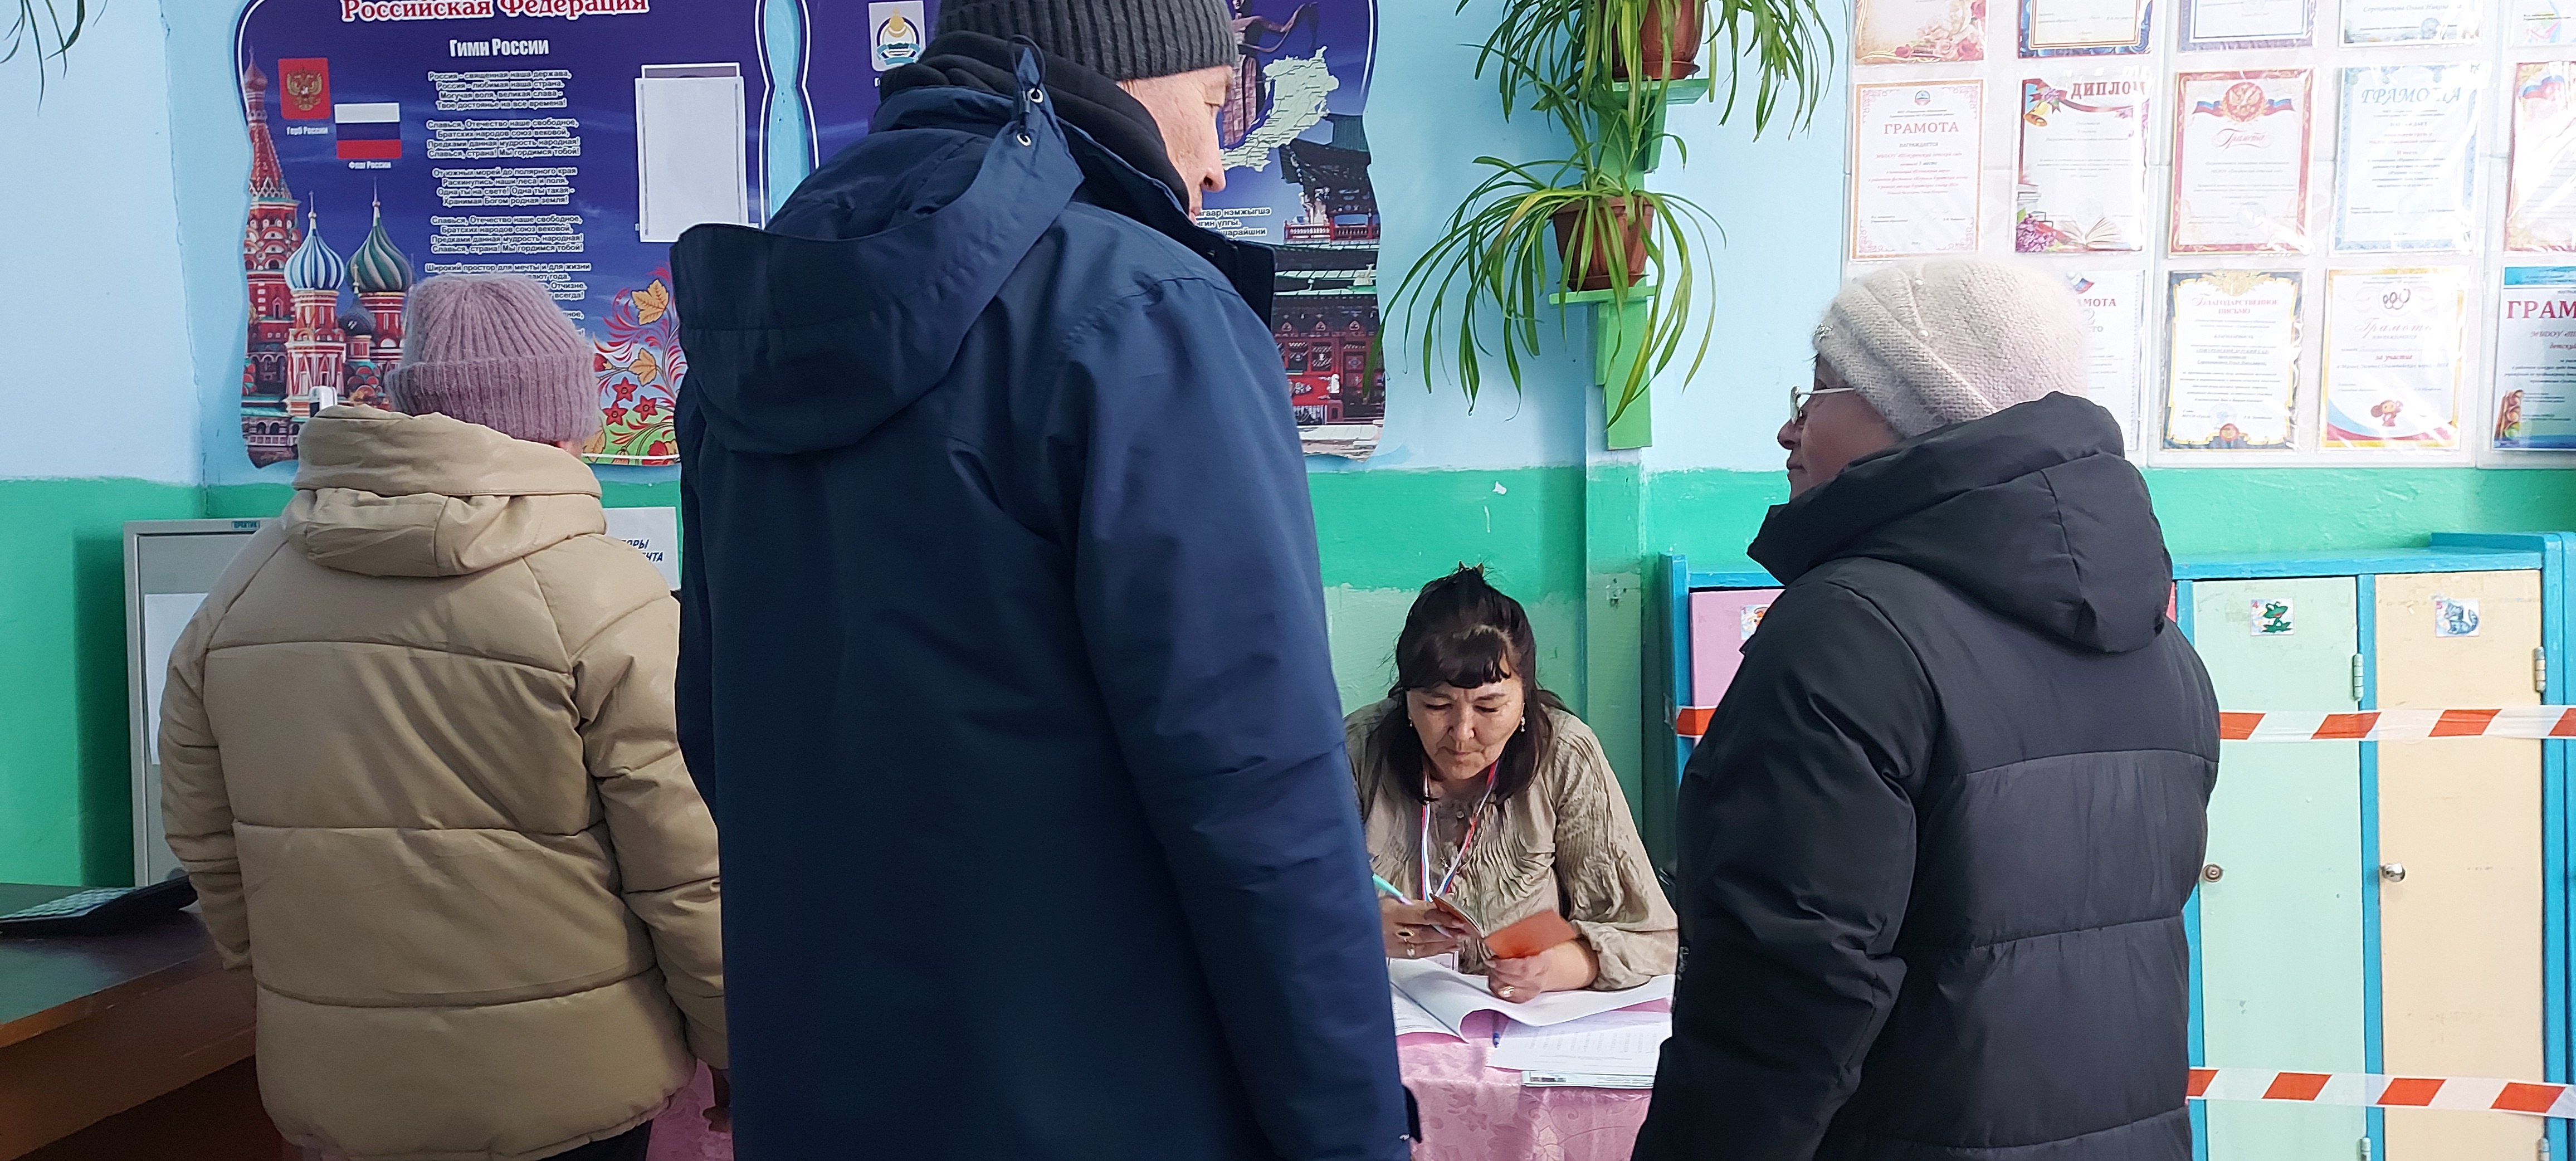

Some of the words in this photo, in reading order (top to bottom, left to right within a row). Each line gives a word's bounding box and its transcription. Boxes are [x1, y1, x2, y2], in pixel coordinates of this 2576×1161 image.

[344, 0, 491, 18] Российская
[502, 0, 646, 17] Федерация
[449, 39, 490, 56] Гимн
[491, 38, 549, 56] России
[532, 70, 571, 79] держава,
[440, 92, 473, 101] Могучая
[2361, 87, 2462, 105] ГРАМОА
[457, 101, 499, 110] достоянье
[529, 99, 565, 109] времена!
[532, 119, 578, 128] свободное,
[1884, 121, 1959, 135] ГРАМОТА
[534, 128, 569, 137] вековой,
[428, 140, 467, 149] Предками
[539, 138, 579, 148] народная!
[2212, 128, 2274, 154] Грамота
[428, 150, 466, 159] Славься,
[467, 148, 497, 159] страна!
[514, 149, 552, 158] гордимся
[554, 147, 579, 156] тобой!
[476, 167, 501, 177] морей
[514, 168, 556, 177] полярного
[443, 179, 494, 188] Раскинулись
[484, 187, 509, 195] свете!
[443, 198, 482, 207] Хранимая
[510, 197, 539, 207] родная
[541, 196, 568, 204] земля!
[432, 217, 467, 226] Славься,
[536, 214, 582, 224] свободное,
[442, 226, 477, 235] Братских
[538, 223, 573, 233] вековой,
[432, 236, 471, 245] Предками
[542, 233, 583, 243] народная!
[432, 246, 470, 254] Славься,
[471, 244, 501, 253] страна!
[518, 244, 555, 253] гордимся
[558, 242, 583, 251] тобой!
[426, 263, 461, 272] Широкий
[554, 291, 583, 301] всегда!
[2252, 601, 2259, 609] 4
